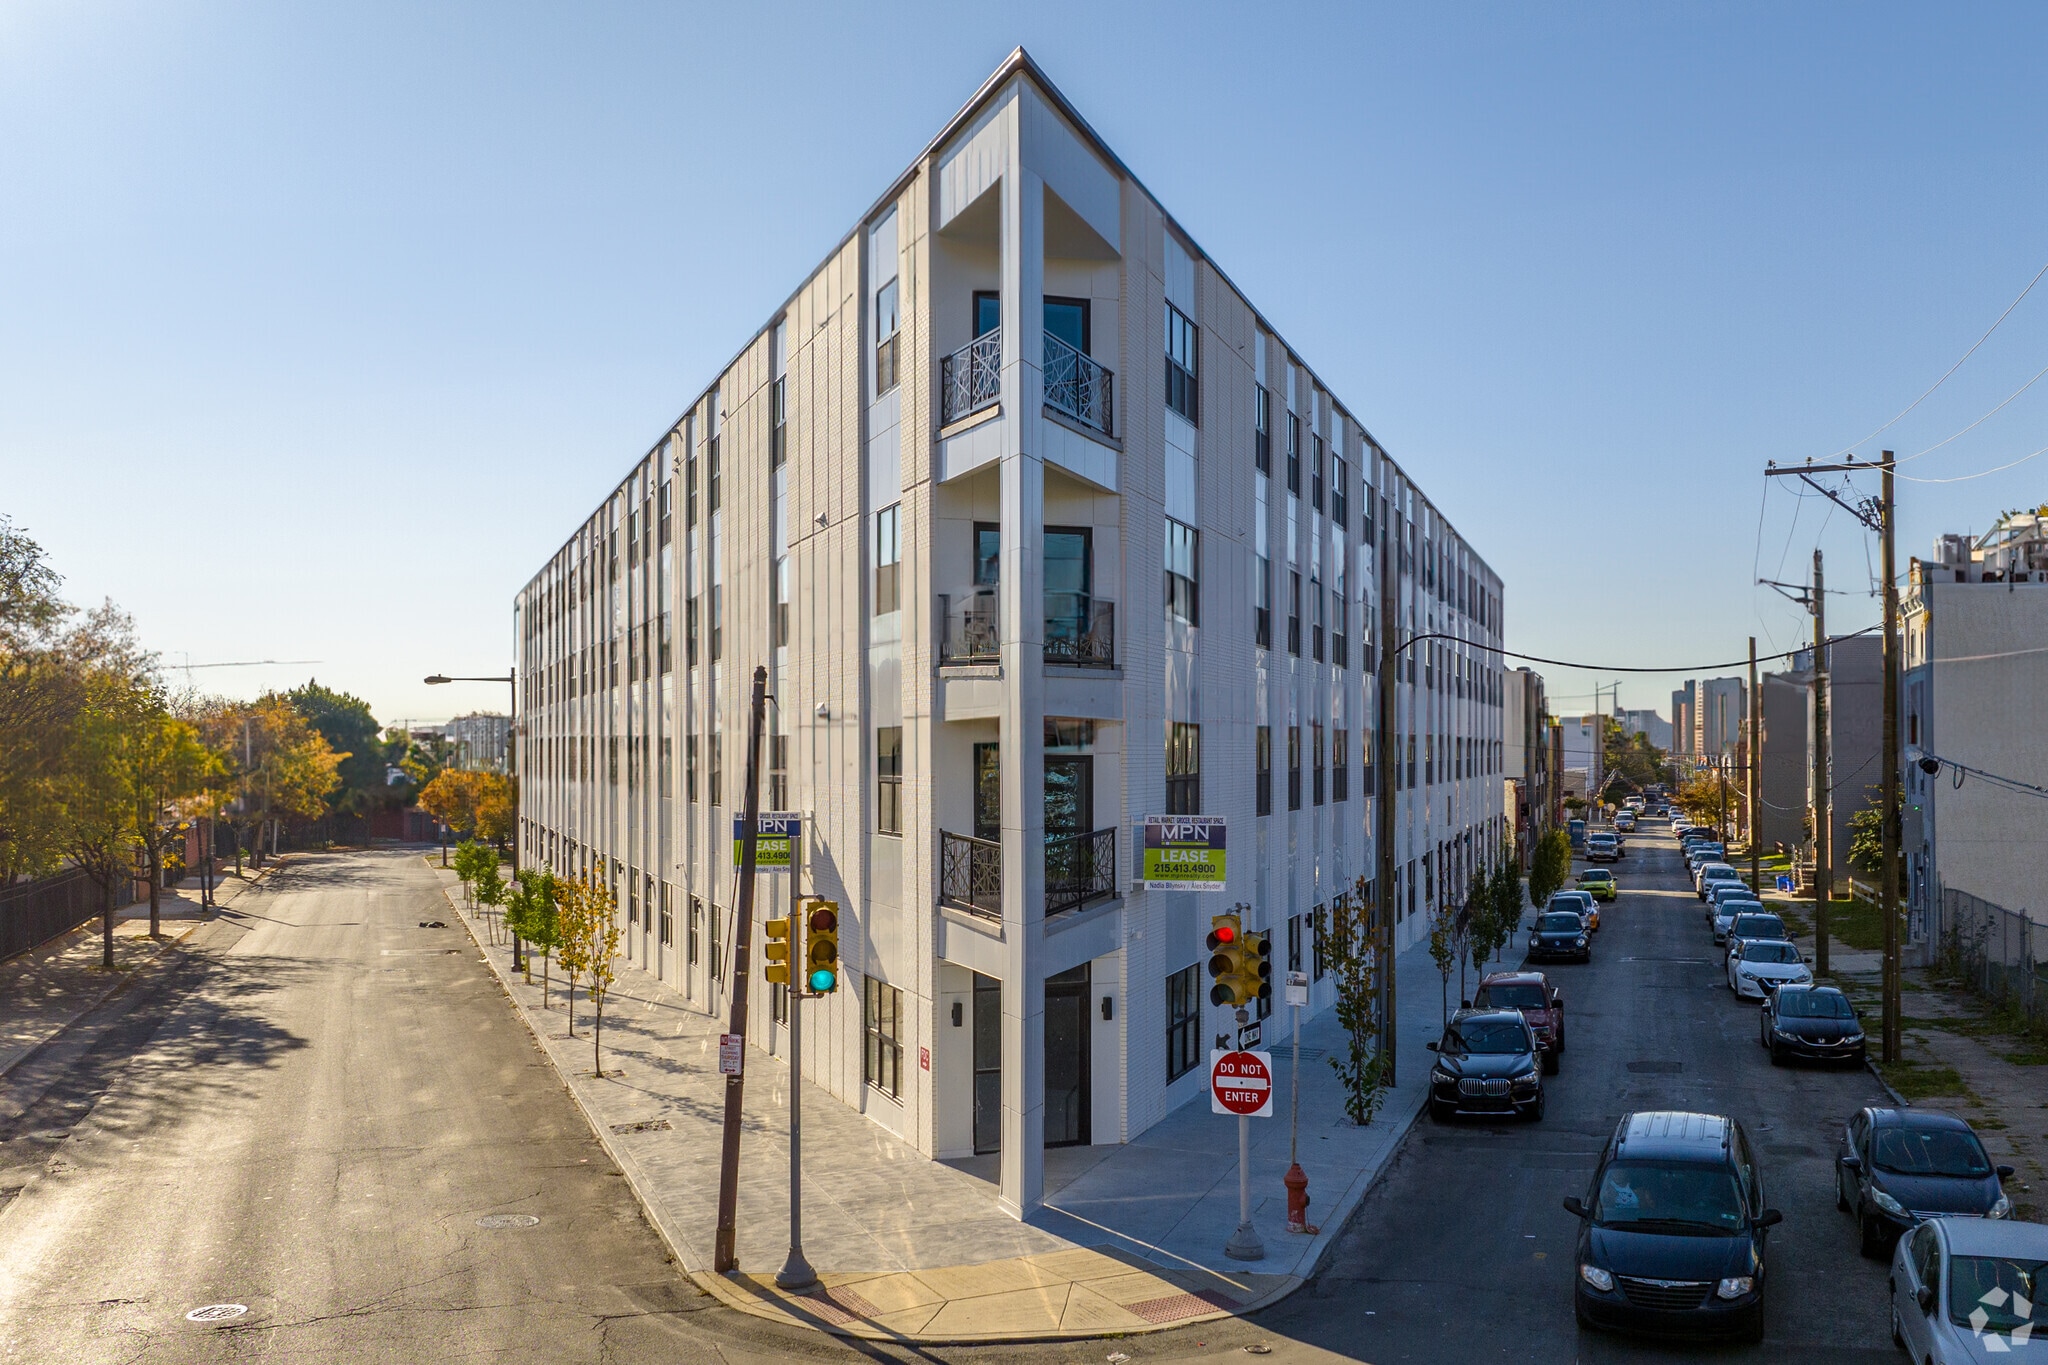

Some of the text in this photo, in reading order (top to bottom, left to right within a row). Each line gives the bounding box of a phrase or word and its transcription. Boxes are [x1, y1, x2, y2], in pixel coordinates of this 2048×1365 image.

[1161, 825, 1209, 839] MPN
[756, 841, 787, 851] EASE
[1161, 850, 1209, 863] LEASE
[1154, 864, 1216, 873] 215.413.4900
[1220, 1063, 1262, 1075] DO NOT
[1225, 1091, 1259, 1103] ENTER
